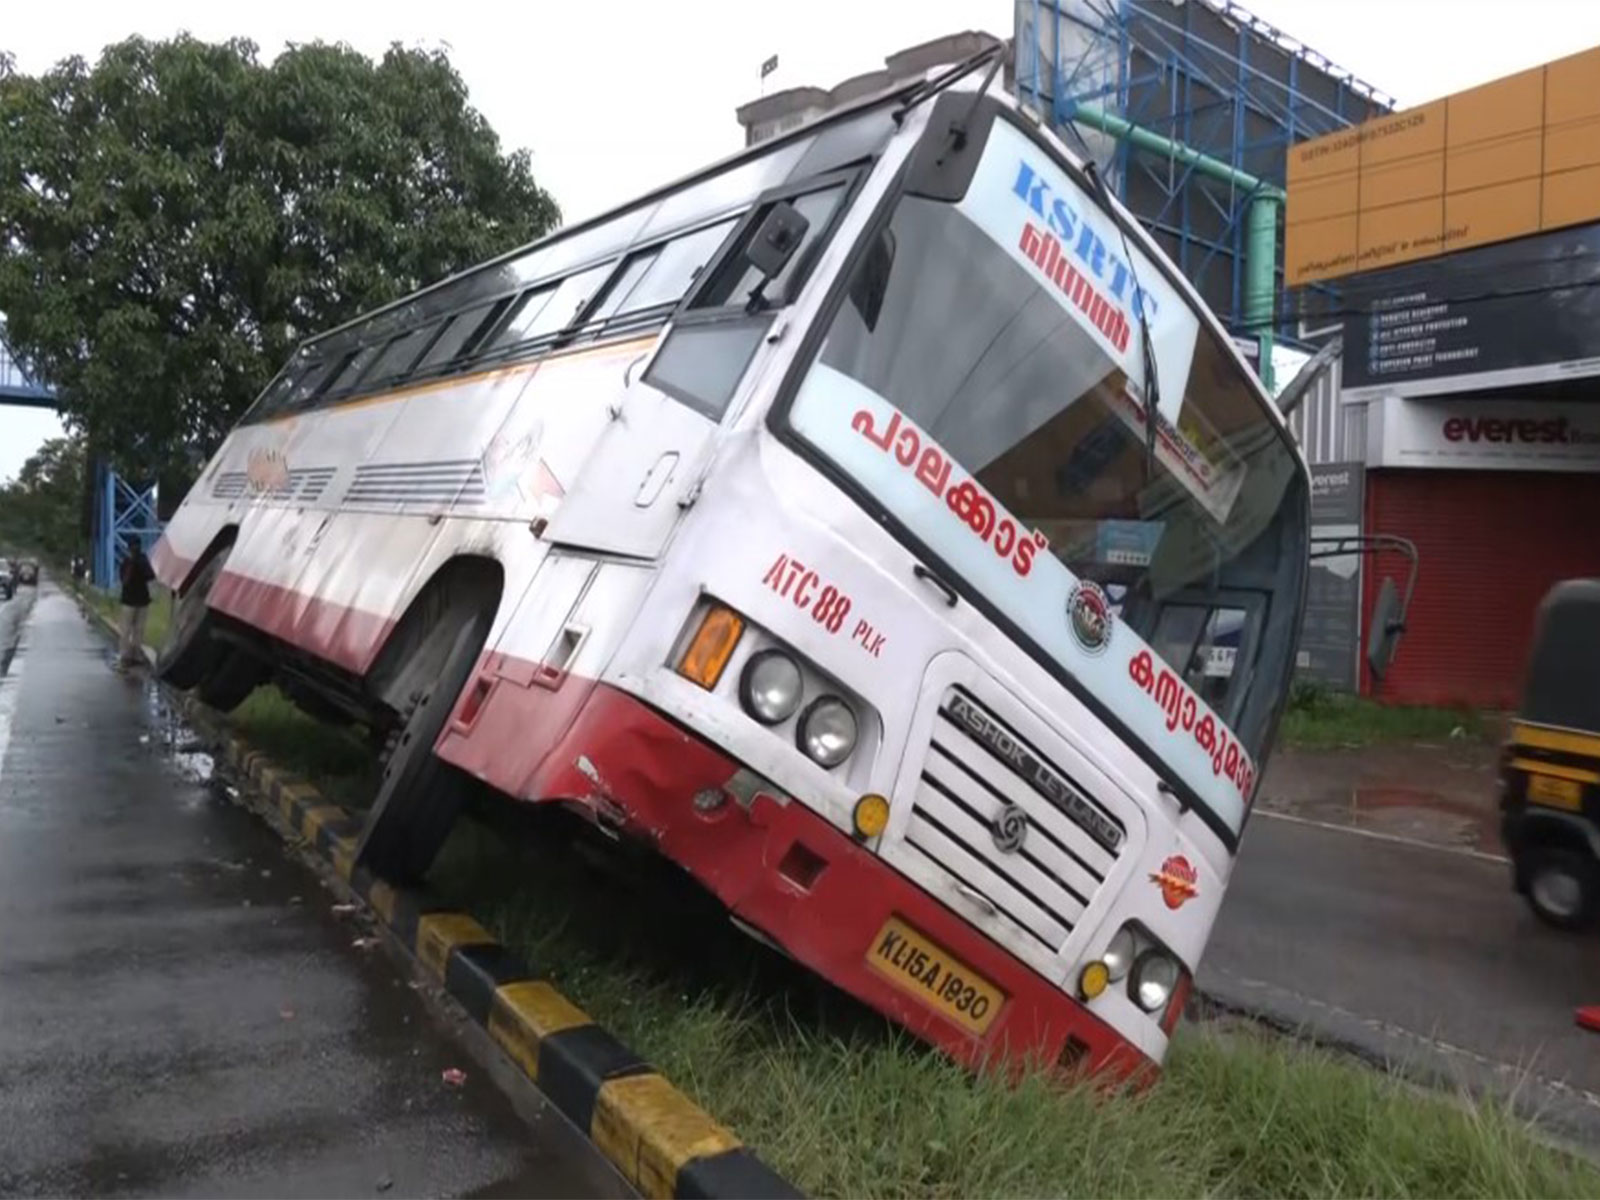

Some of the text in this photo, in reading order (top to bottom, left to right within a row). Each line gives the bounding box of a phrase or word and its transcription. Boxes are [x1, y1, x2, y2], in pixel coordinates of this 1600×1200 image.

[1012, 159, 1159, 326] KSRTC
[1443, 413, 1568, 444] everest
[851, 409, 1048, 578] പാലക്കാട്
[1312, 471, 1350, 487] verest
[762, 553, 852, 635] ATC 88
[851, 618, 887, 659] PLK
[951, 700, 1124, 847] ASHOK LEYLAND
